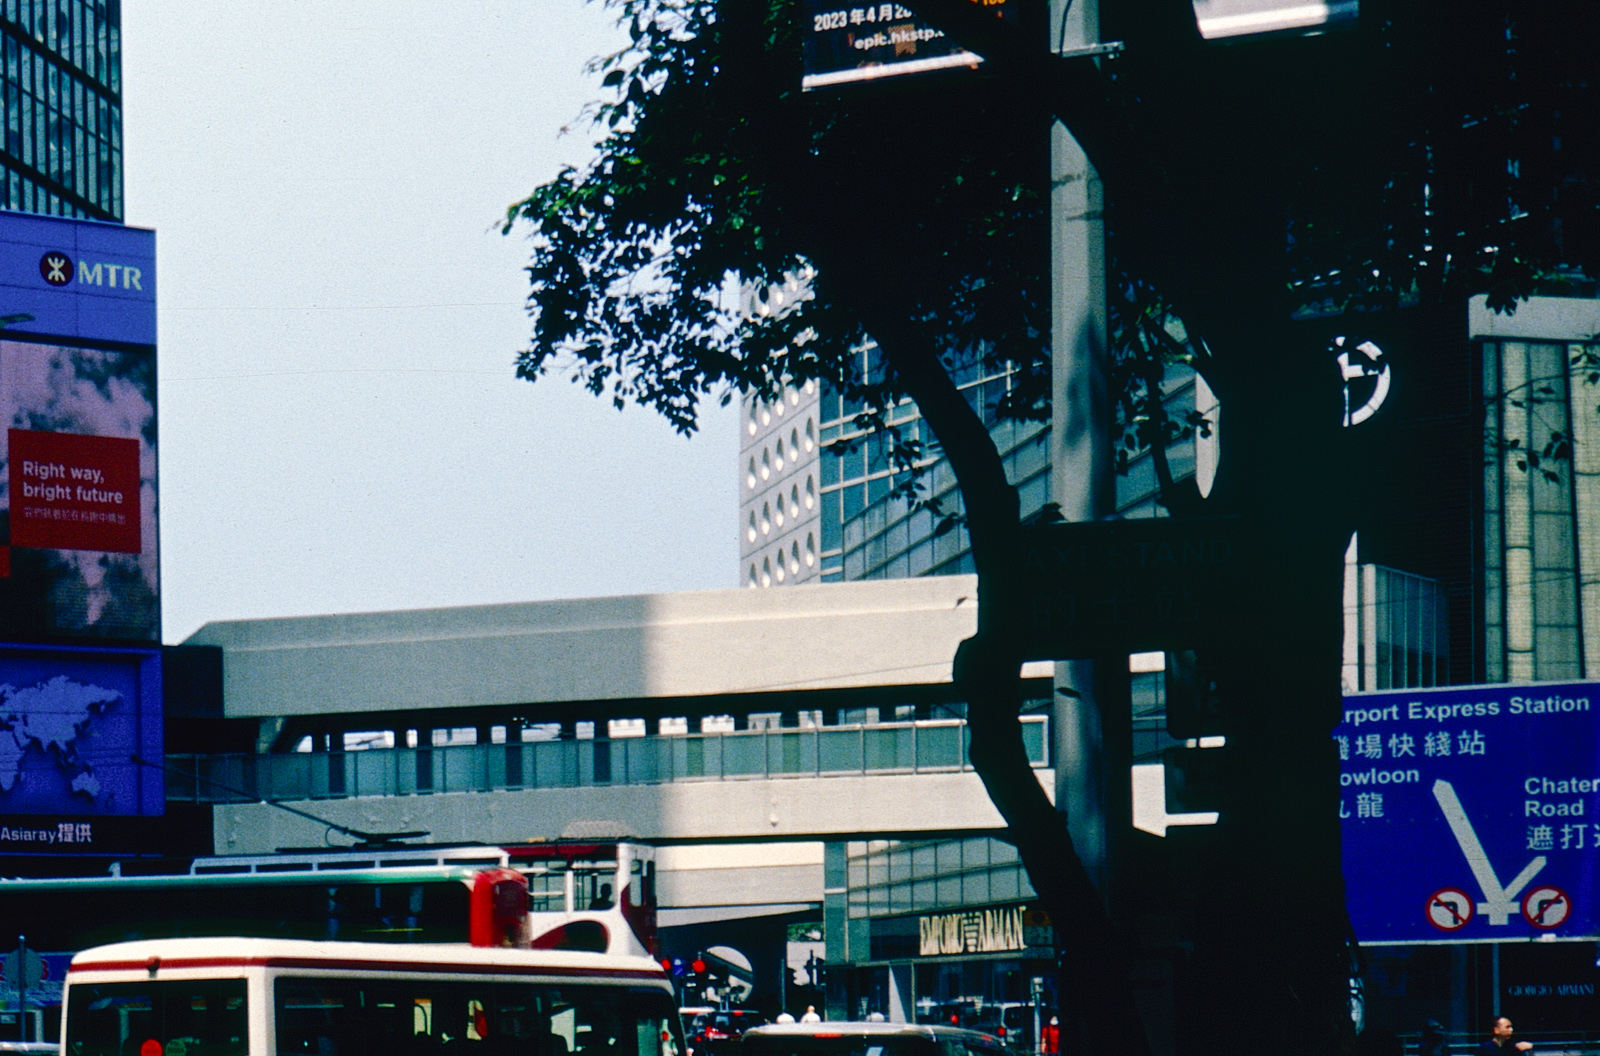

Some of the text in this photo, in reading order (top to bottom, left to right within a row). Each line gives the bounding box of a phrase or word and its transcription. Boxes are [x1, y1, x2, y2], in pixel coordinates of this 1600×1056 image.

[78, 261, 143, 291] MTR
[22, 460, 105, 484] Right way,
[22, 481, 124, 505] bright future
[1344, 696, 1590, 727] rport Express Station
[1340, 768, 1420, 786] owloon
[1524, 777, 1600, 795] Chater
[1524, 799, 1584, 817] Road
[1526, 823, 1600, 851] 遮打
